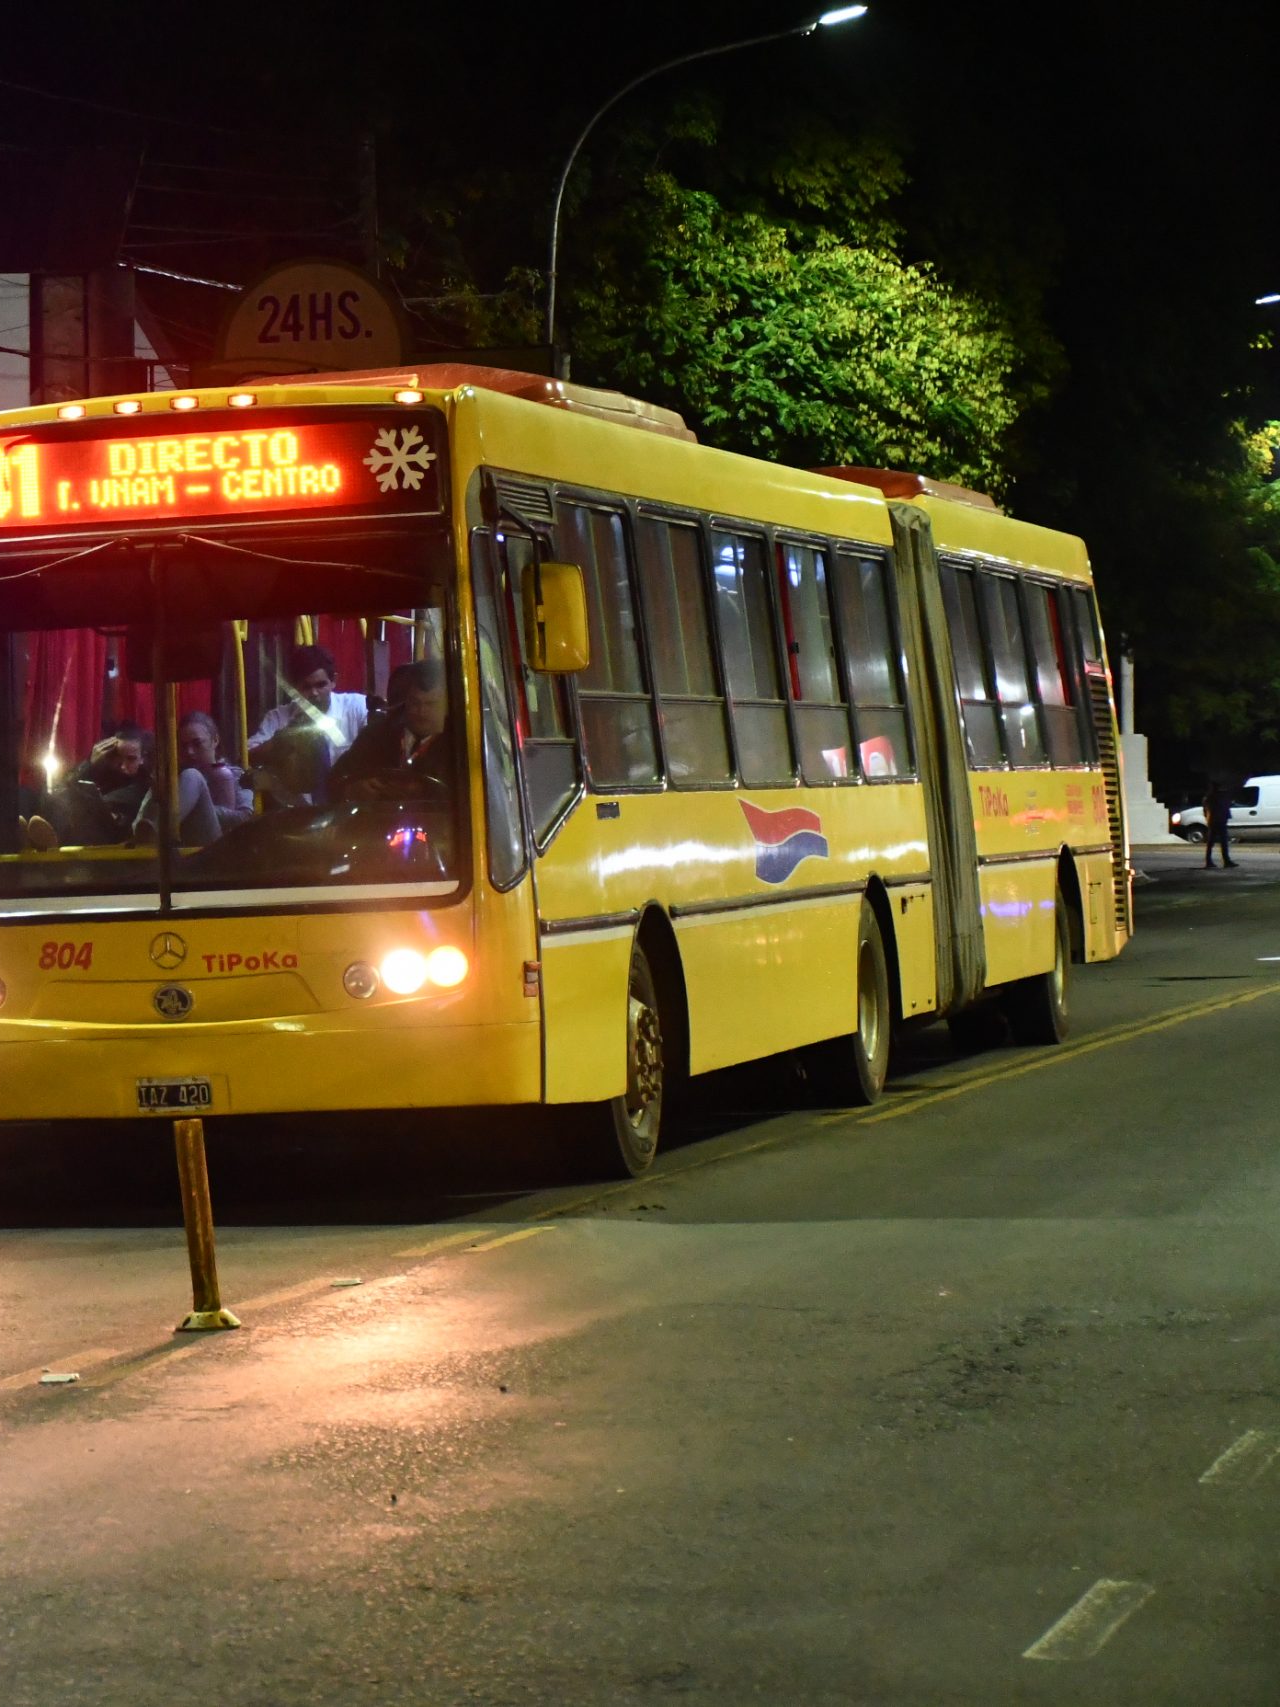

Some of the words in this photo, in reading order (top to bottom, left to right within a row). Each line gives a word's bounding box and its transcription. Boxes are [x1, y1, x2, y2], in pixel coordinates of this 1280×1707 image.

[258, 290, 373, 344] 24HS.
[108, 431, 300, 477] DIRECTO
[221, 463, 342, 501] CENTRO
[38, 941, 94, 971] 804
[202, 951, 299, 974] TiPoKa
[179, 1084, 210, 1105] 420
